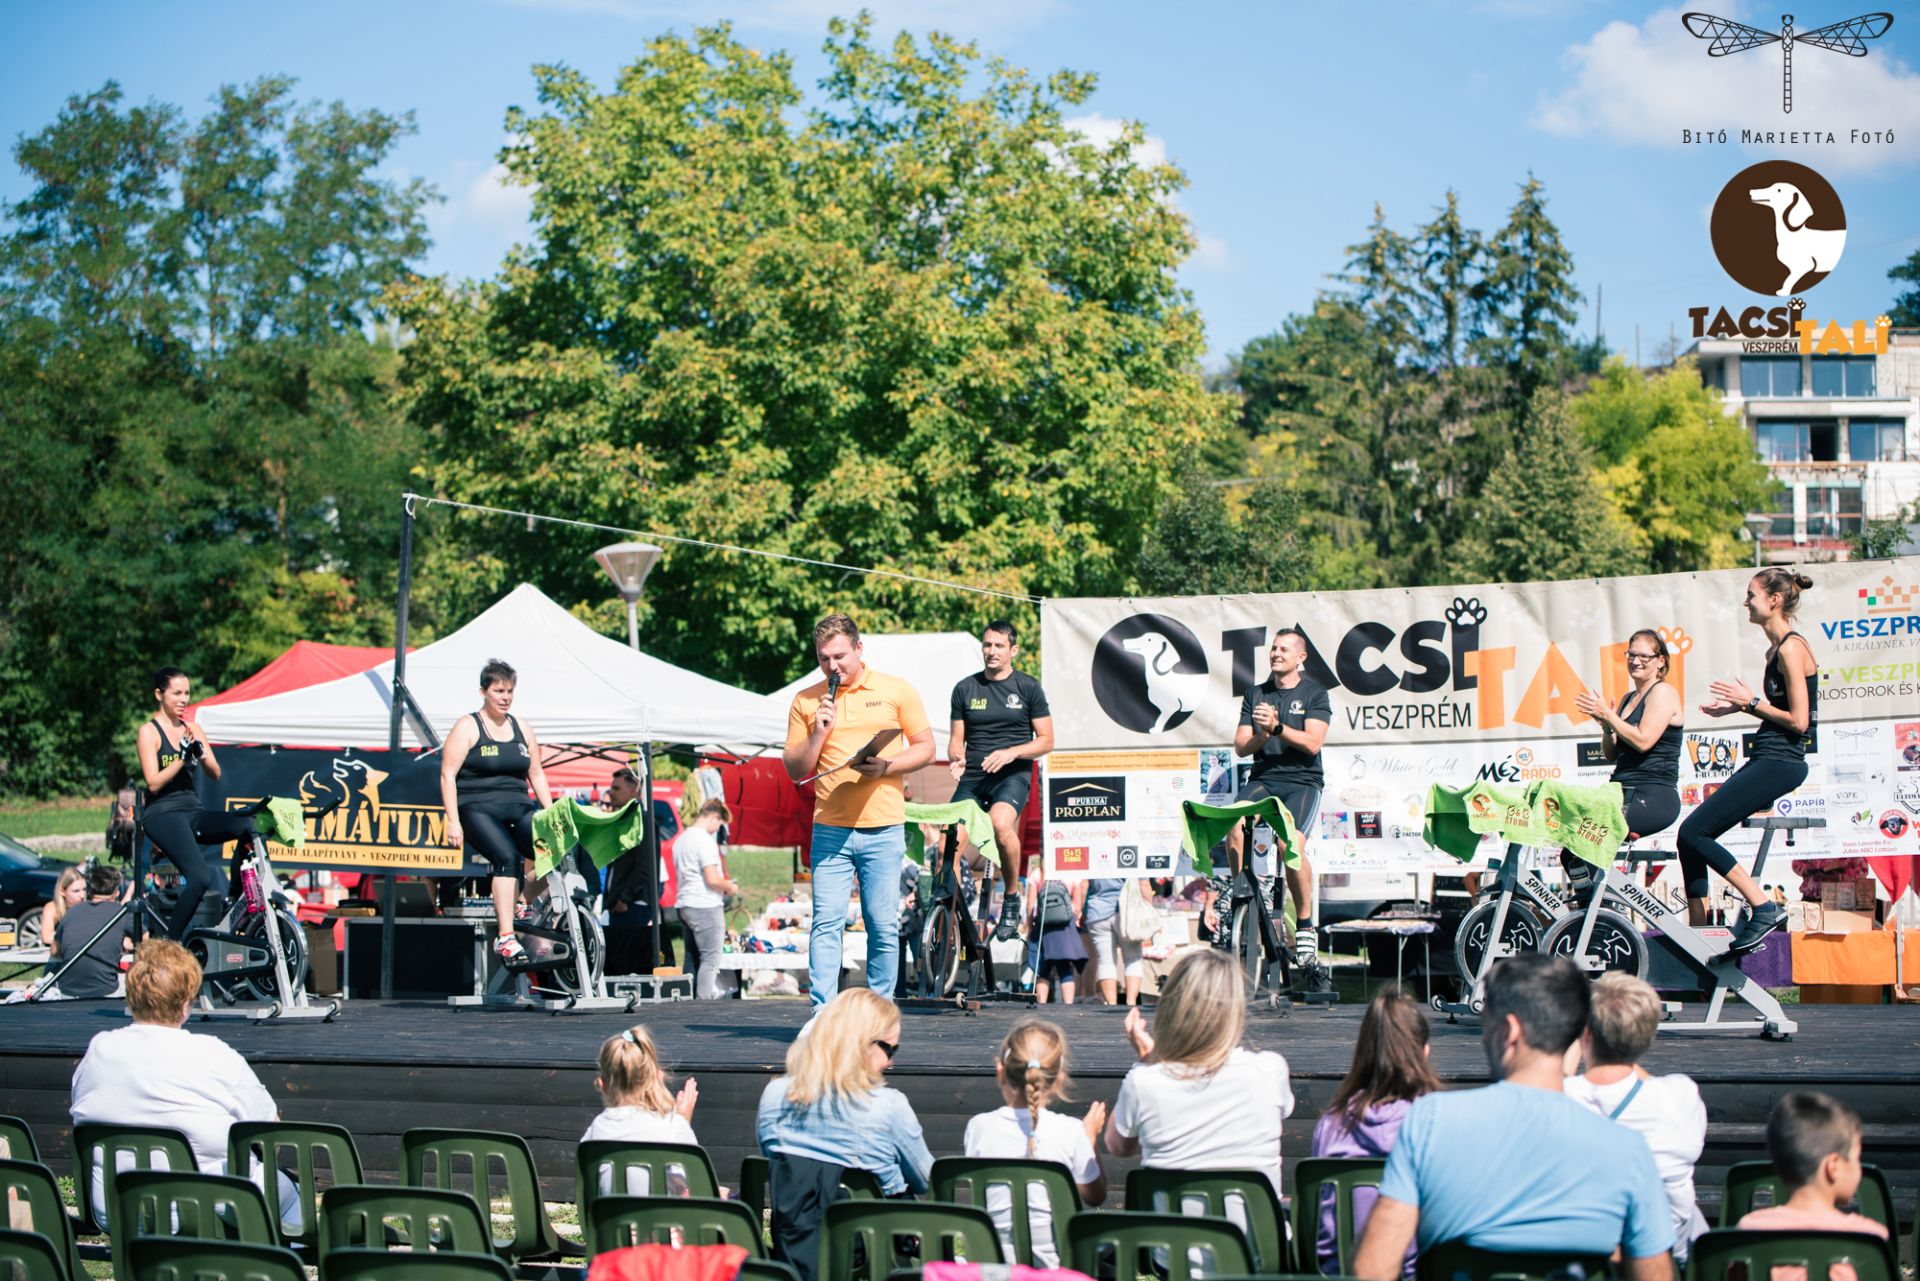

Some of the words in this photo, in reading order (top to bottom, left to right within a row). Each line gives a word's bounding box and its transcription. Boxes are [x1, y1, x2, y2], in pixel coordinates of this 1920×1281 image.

[1844, 638, 1906, 653] KIRÁLYNÉK
[1816, 685, 1896, 701] LOSTOROK
[1346, 696, 1472, 731] VESZPRÉM
[1075, 797, 1107, 806] PURINA
[1795, 798, 1826, 808] PAPÍR
[1084, 805, 1121, 817] PLAN
[1796, 807, 1827, 816] CENTER
[302, 847, 358, 861] ALAPÍTVÁNY
[370, 851, 421, 863] VESZPRÉM
[424, 854, 458, 866] MEGYE
[1524, 876, 1562, 912] SPINNER
[1619, 882, 1666, 920] SPINNER
